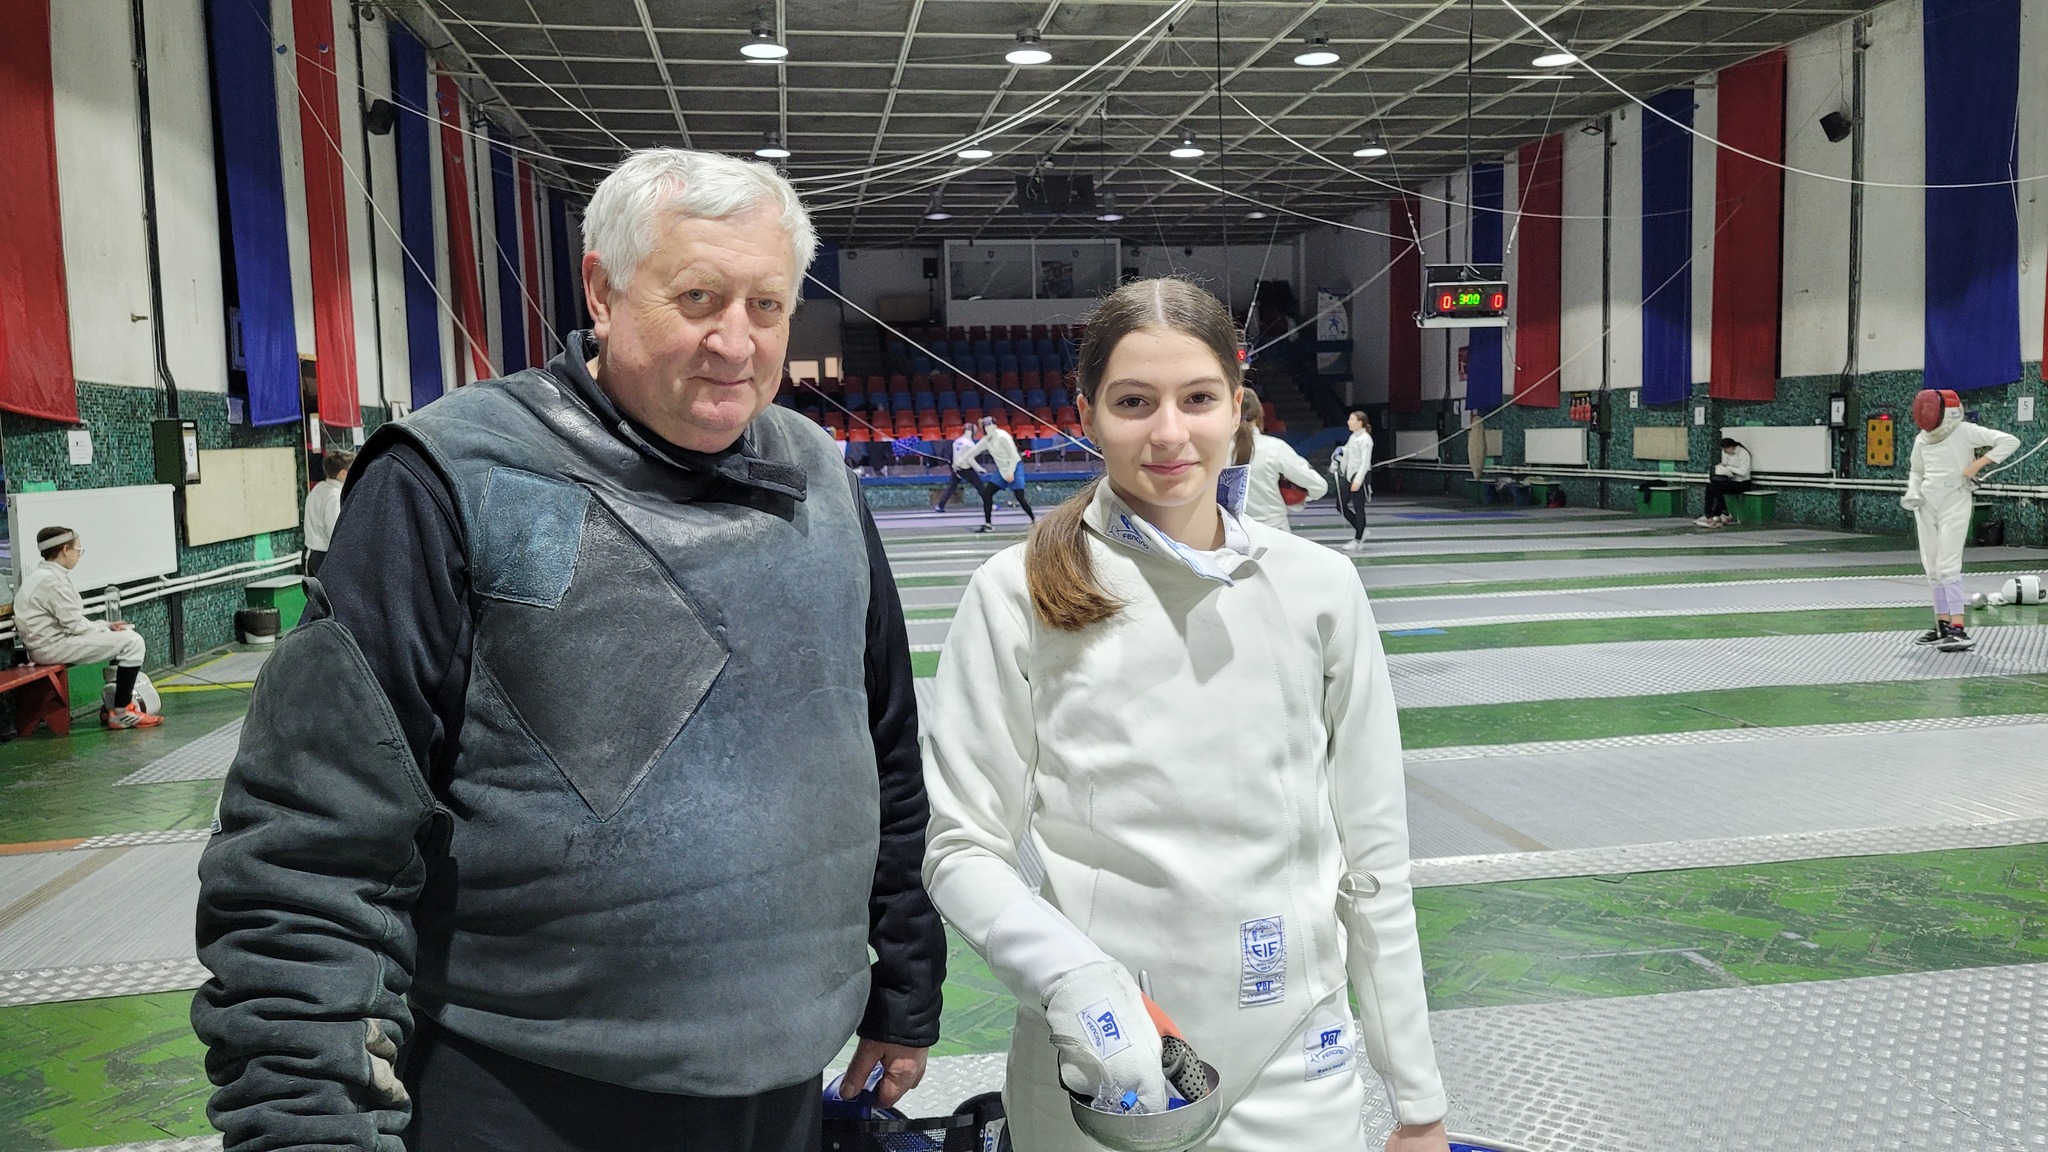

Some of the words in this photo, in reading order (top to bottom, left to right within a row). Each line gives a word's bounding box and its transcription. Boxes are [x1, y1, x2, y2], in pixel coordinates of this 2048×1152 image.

[1442, 295, 1451, 309] 0
[1459, 293, 1481, 305] 3:00
[1494, 294, 1503, 308] 0
[2023, 400, 2029, 411] 5
[188, 443, 193, 457] 6
[1255, 980, 1274, 992] PBT
[1097, 1011, 1121, 1040] PBT
[1320, 1029, 1342, 1048] PBT
